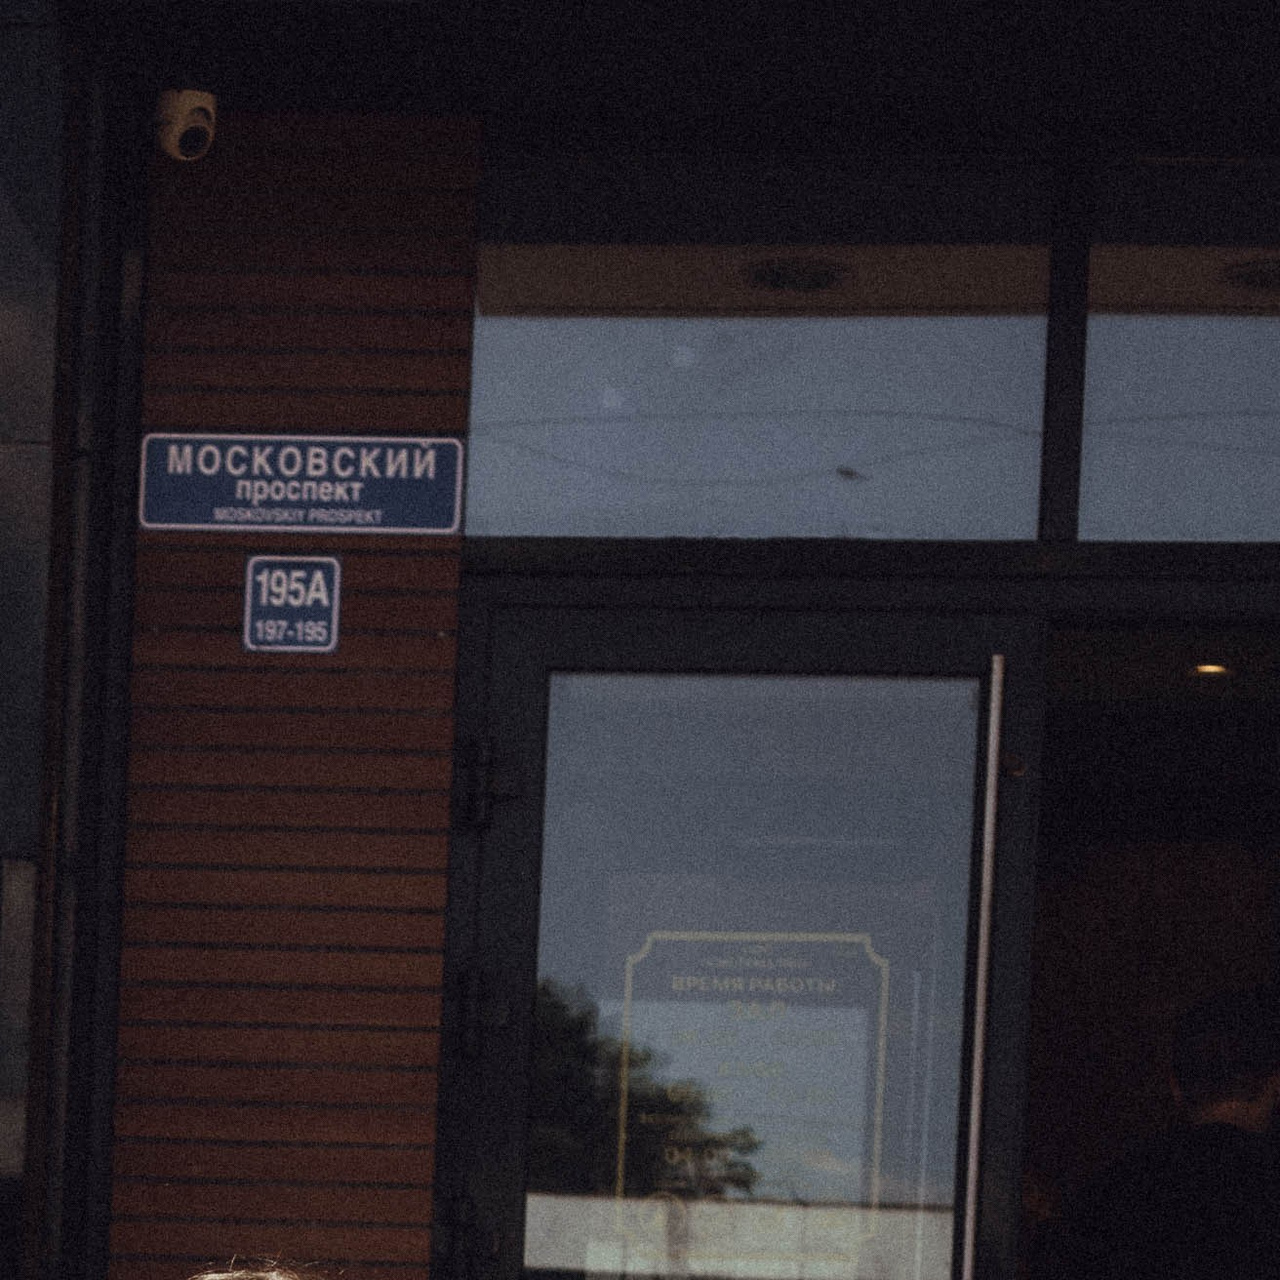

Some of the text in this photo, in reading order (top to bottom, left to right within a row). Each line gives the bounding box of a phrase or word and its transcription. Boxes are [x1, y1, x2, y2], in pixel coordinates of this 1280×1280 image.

[167, 439, 436, 479] МОСКОВСКИЙ
[235, 479, 364, 505] проспект
[255, 569, 330, 607] 195А
[255, 619, 328, 642] 197-195
